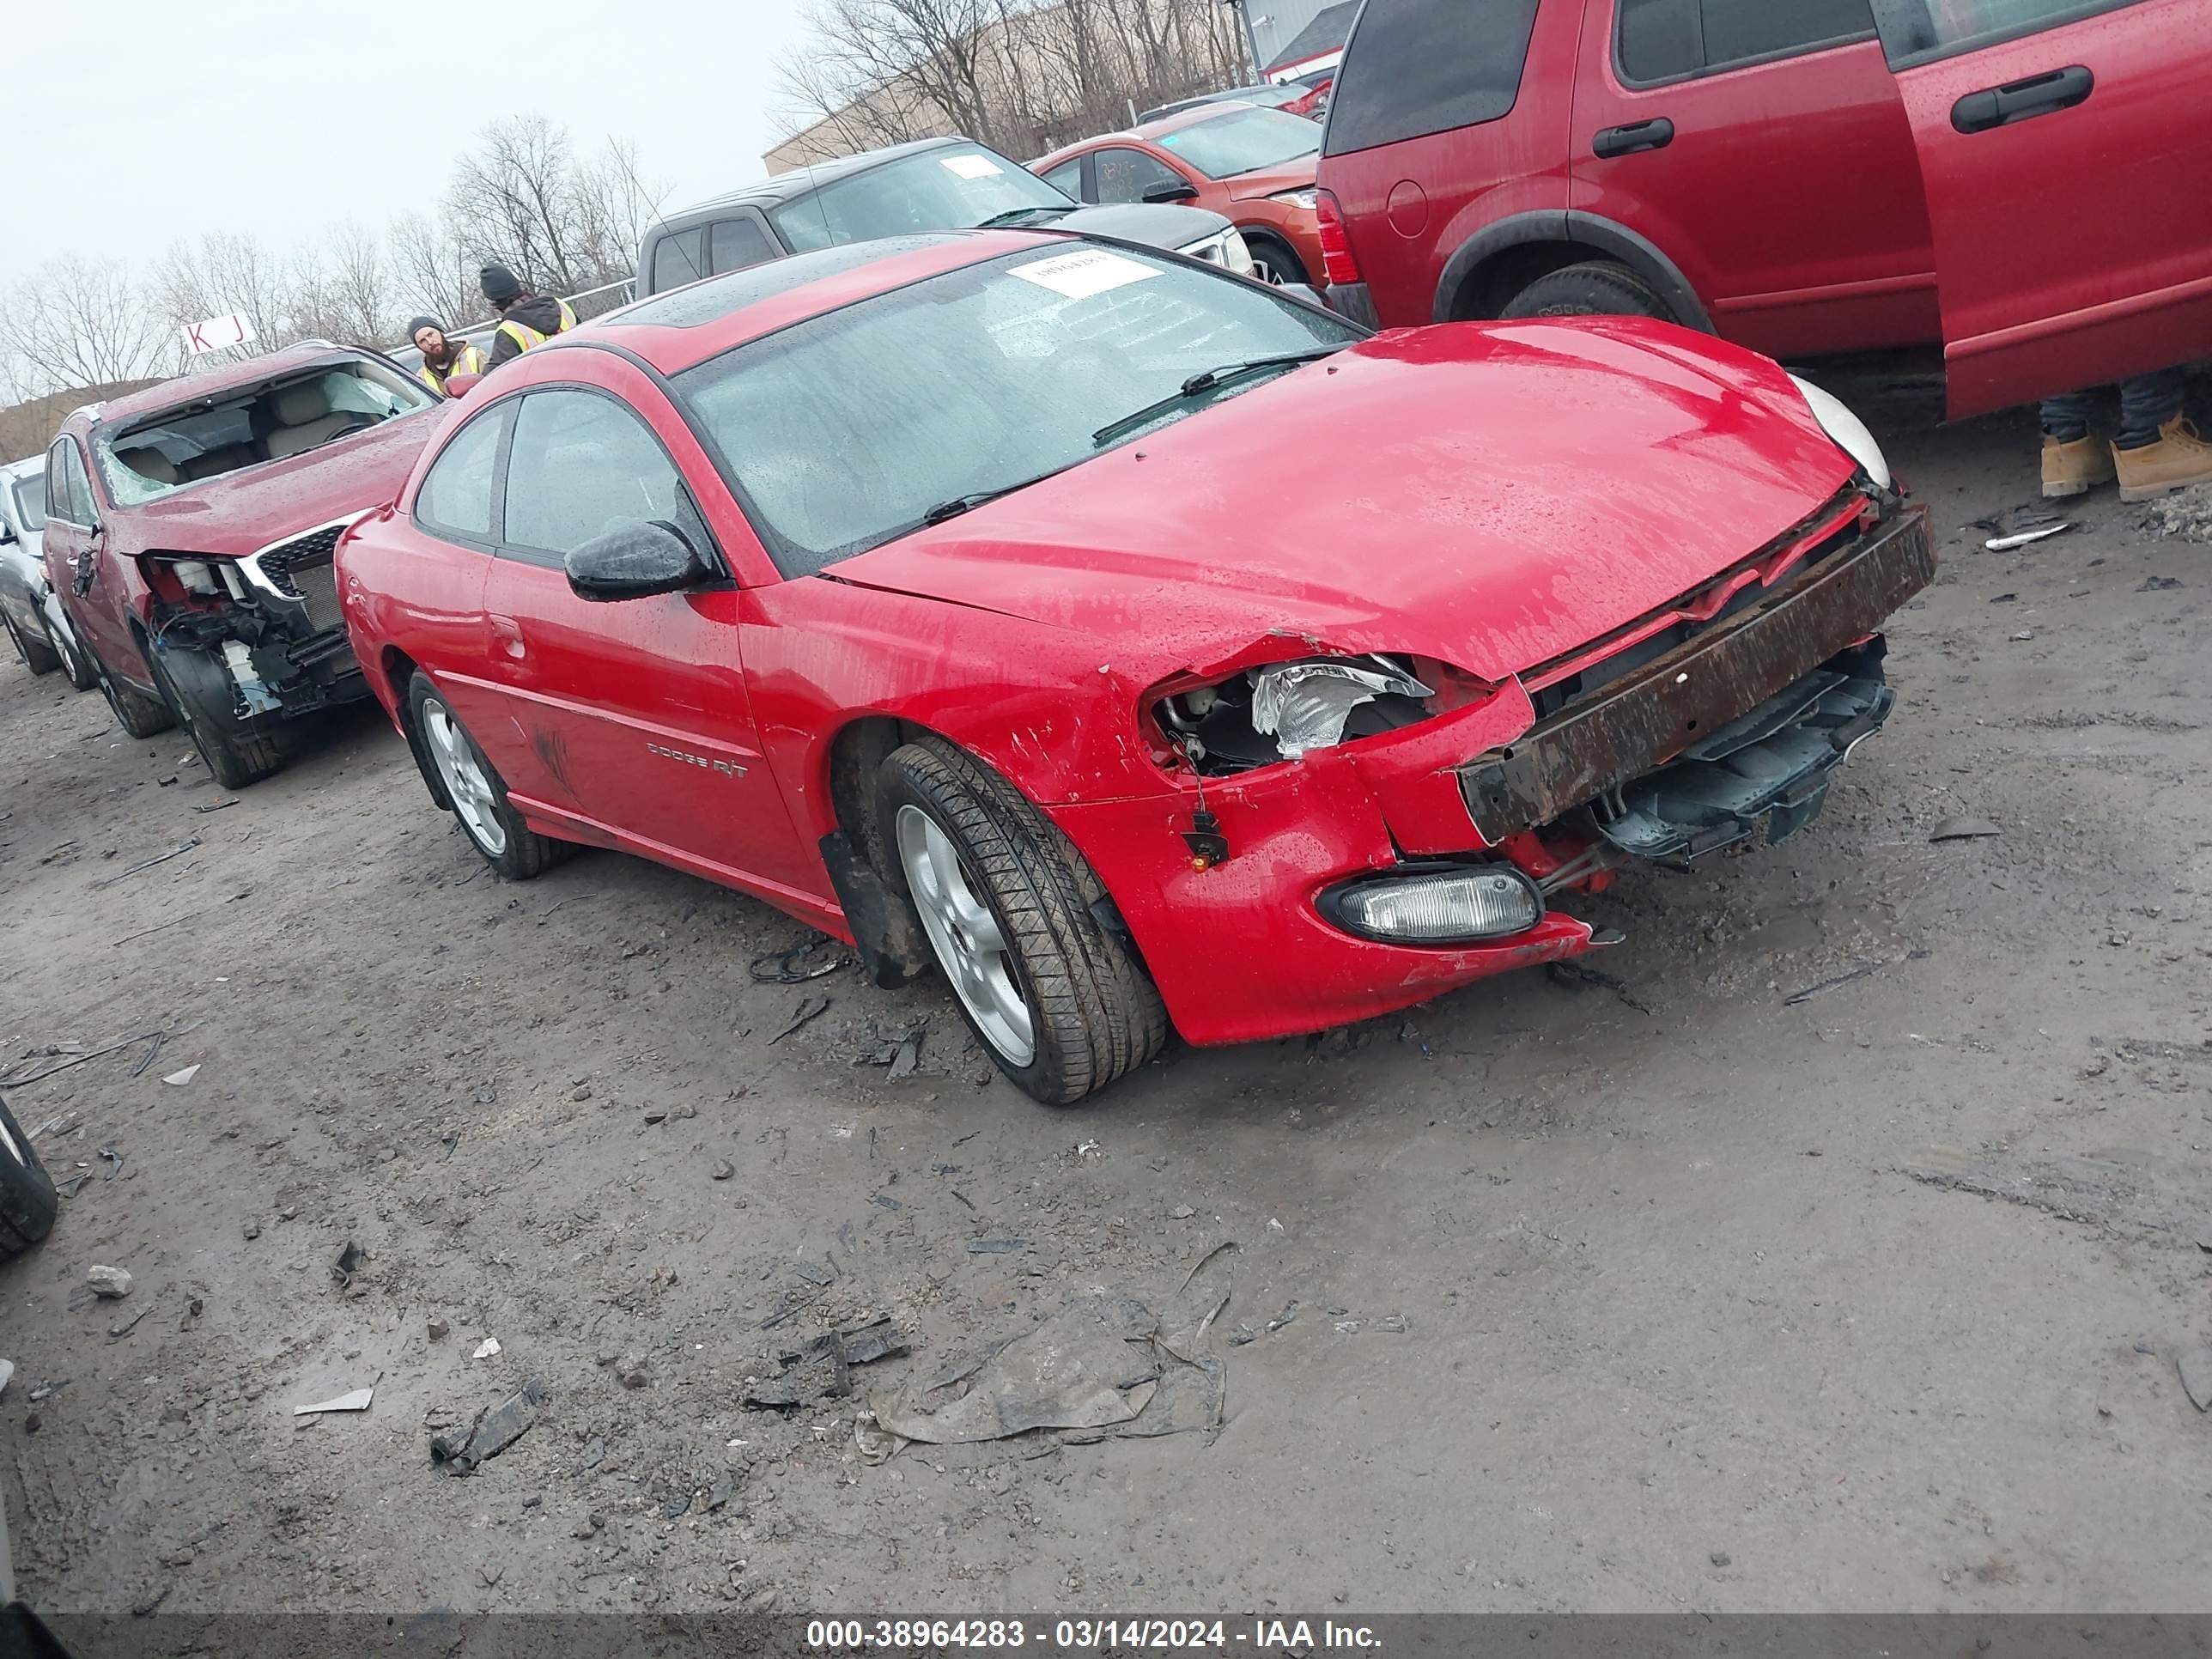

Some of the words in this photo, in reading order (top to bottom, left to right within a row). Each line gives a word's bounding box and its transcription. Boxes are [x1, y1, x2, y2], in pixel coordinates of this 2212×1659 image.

[187, 324, 213, 353] K
[233, 315, 245, 343] J
[646, 742, 708, 768] DODGE
[713, 759, 749, 779] R/T
